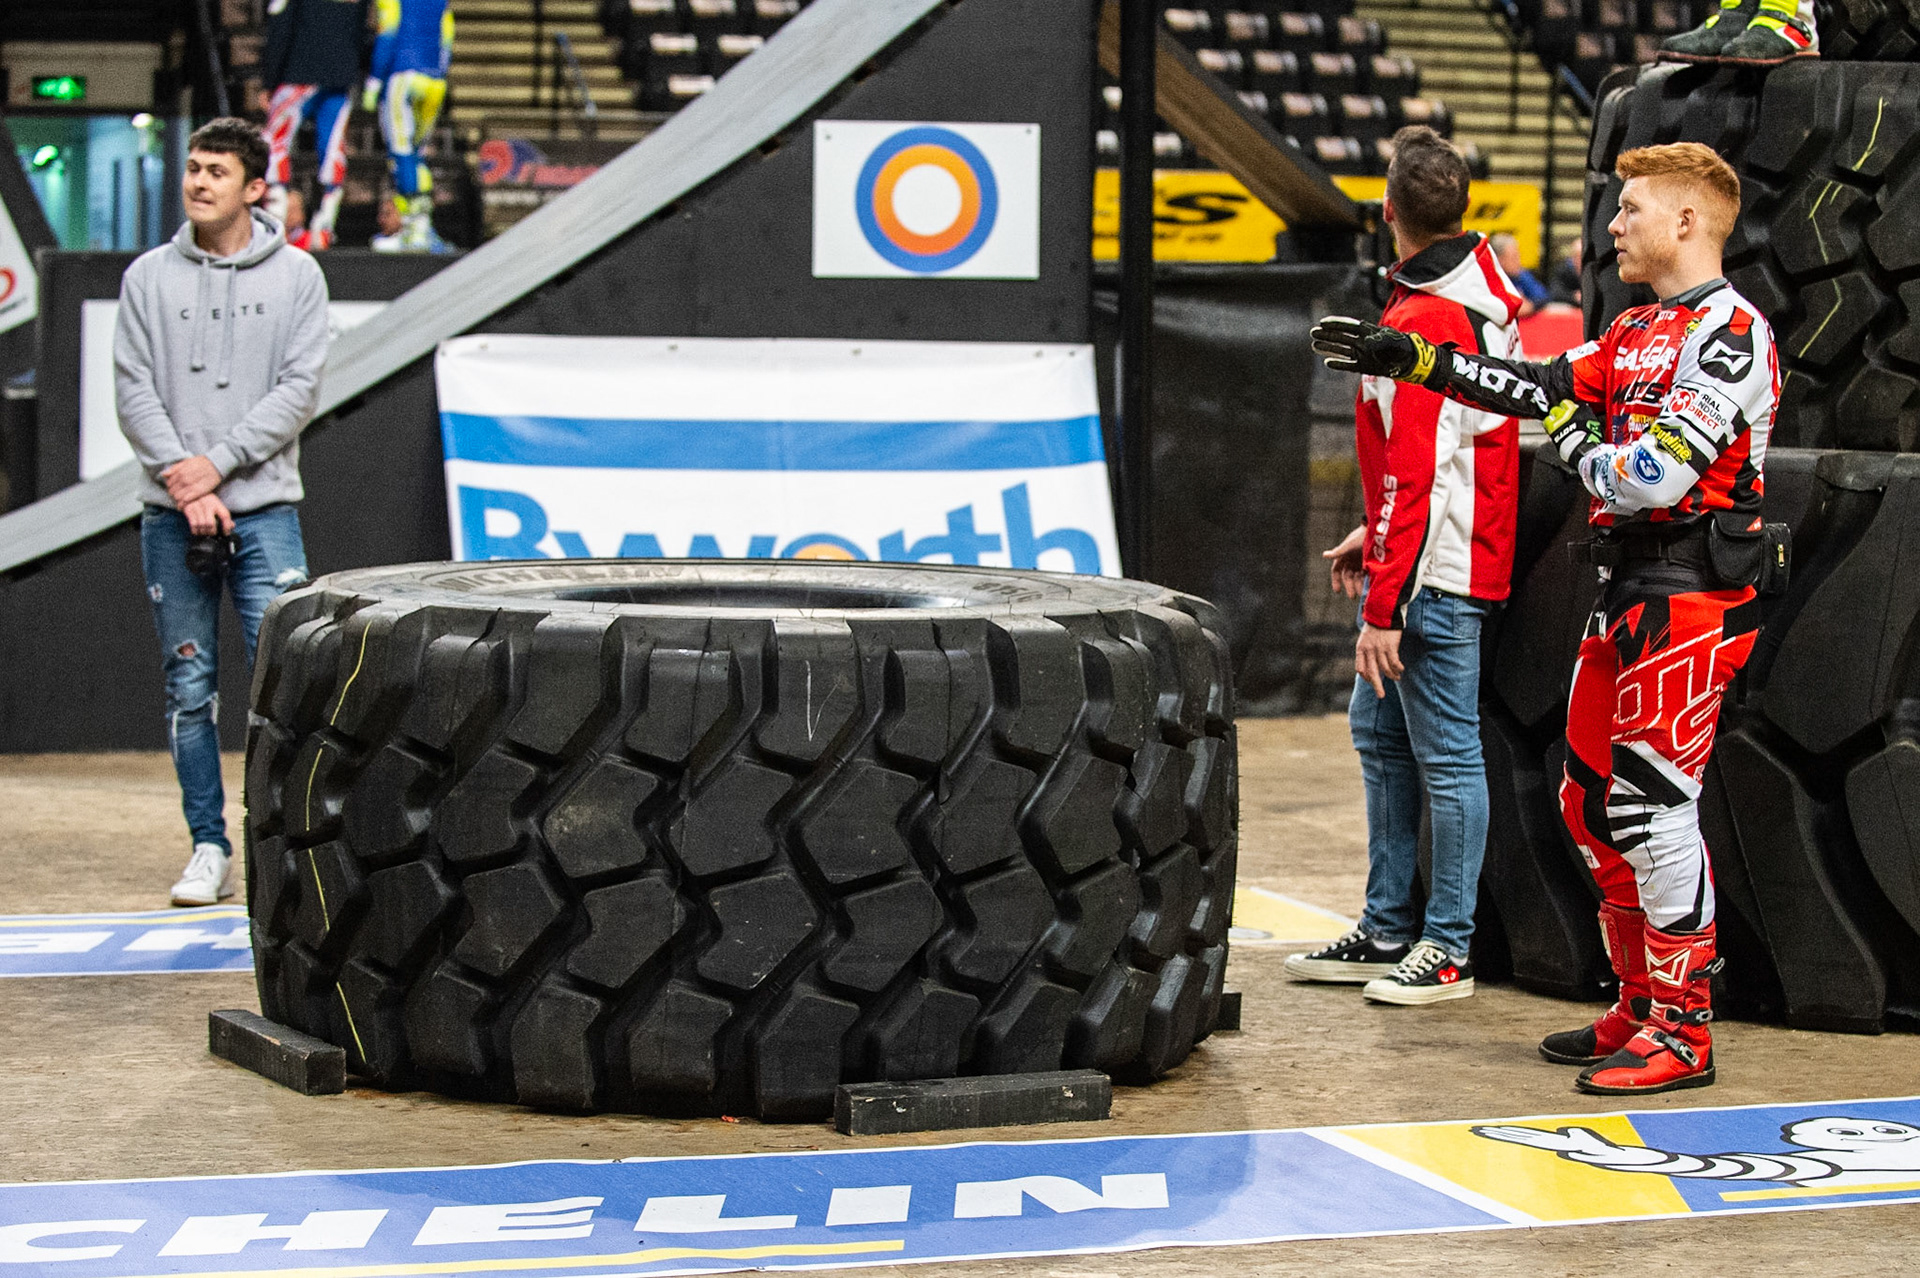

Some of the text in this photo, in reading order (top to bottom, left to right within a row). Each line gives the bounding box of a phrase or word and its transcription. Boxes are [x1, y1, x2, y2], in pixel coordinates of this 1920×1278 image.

[179, 303, 265, 320] CETE
[1696, 400, 1727, 427] NDURO
[1373, 473, 1398, 563] GASGAS
